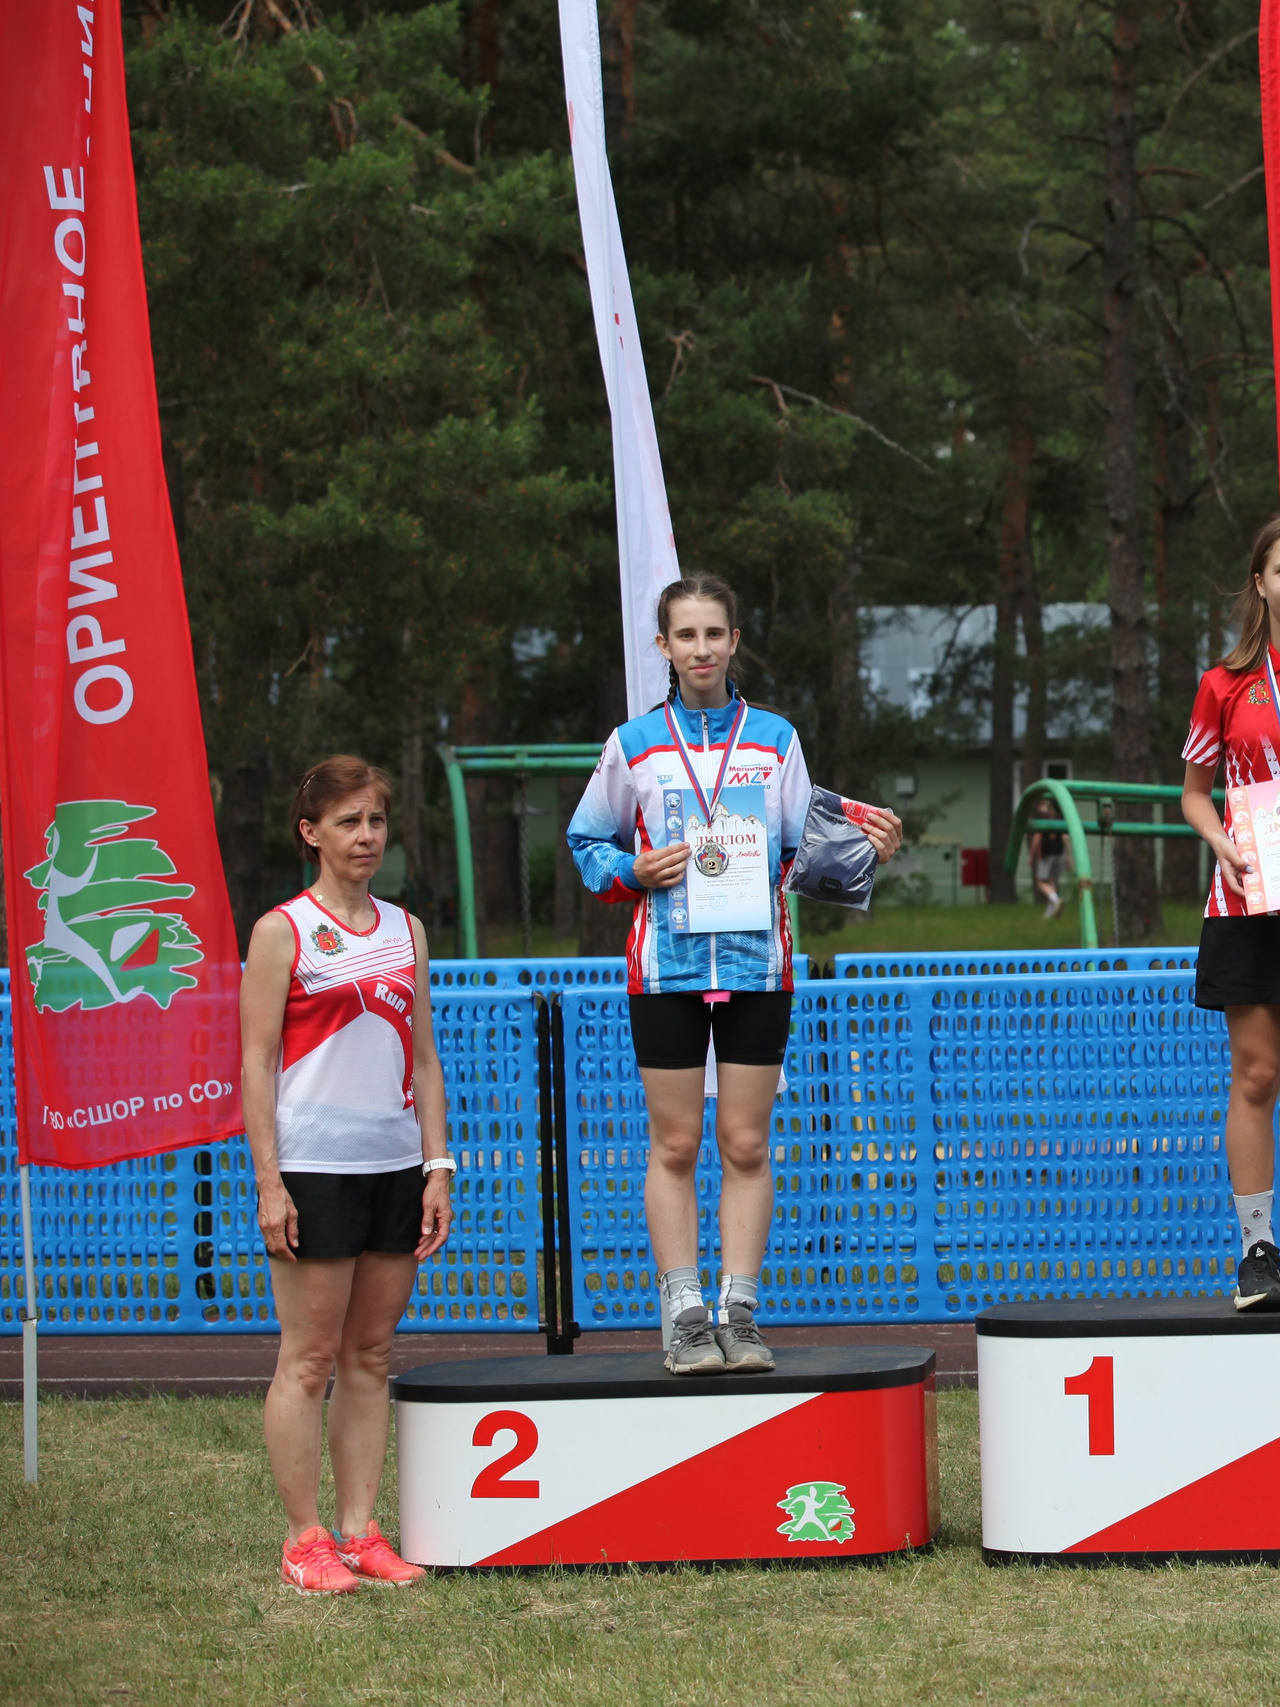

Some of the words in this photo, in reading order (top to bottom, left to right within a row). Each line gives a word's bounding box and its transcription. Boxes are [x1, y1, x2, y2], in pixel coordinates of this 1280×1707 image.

[708, 861, 716, 870] 2
[374, 982, 407, 1014] Run
[66, 1096, 145, 1128] «СШОР
[153, 1093, 183, 1112] по
[189, 1079, 233, 1103] СО»
[1064, 1356, 1115, 1456] 1
[470, 1410, 540, 1499] 2
